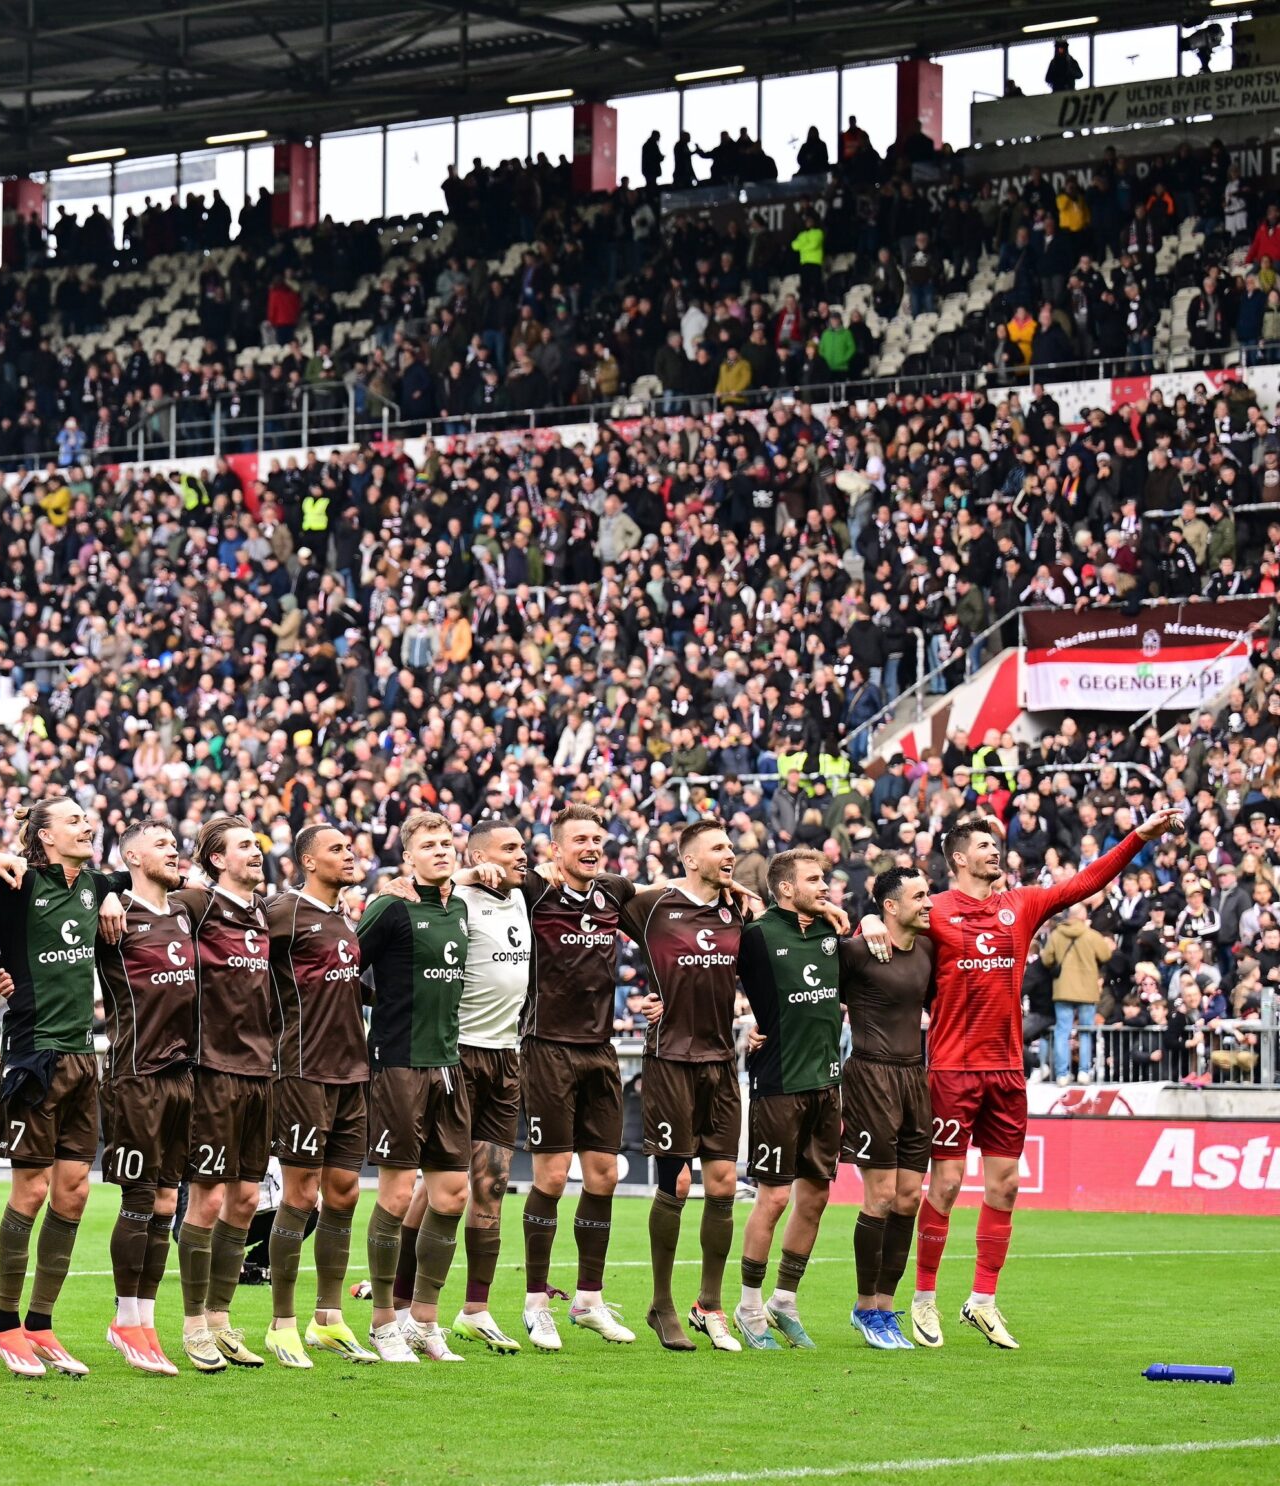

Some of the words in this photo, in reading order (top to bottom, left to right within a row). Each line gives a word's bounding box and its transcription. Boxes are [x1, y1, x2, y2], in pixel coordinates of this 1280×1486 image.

[1126, 83, 1171, 102] ULTRA
[1177, 79, 1210, 95] FAIR
[1126, 104, 1167, 120] MADE
[1172, 100, 1190, 114] BY
[1194, 96, 1212, 112] FC
[1216, 94, 1237, 110] ST.
[1079, 671, 1224, 691] GEGENGERADE
[560, 931, 614, 948] congstar
[677, 952, 736, 969] congstar
[957, 955, 1016, 973] congstar
[788, 987, 838, 1004] congstar
[829, 1062, 840, 1078] 25
[9, 1120, 26, 1152] 7
[290, 1123, 319, 1157] 14
[375, 1129, 391, 1159] 4
[530, 1116, 543, 1146] 5
[657, 1121, 673, 1151] 3
[856, 1130, 872, 1160] 2
[931, 1117, 961, 1147] 22
[115, 1146, 145, 1180] 10
[198, 1144, 226, 1176] 24
[754, 1142, 783, 1174] 21
